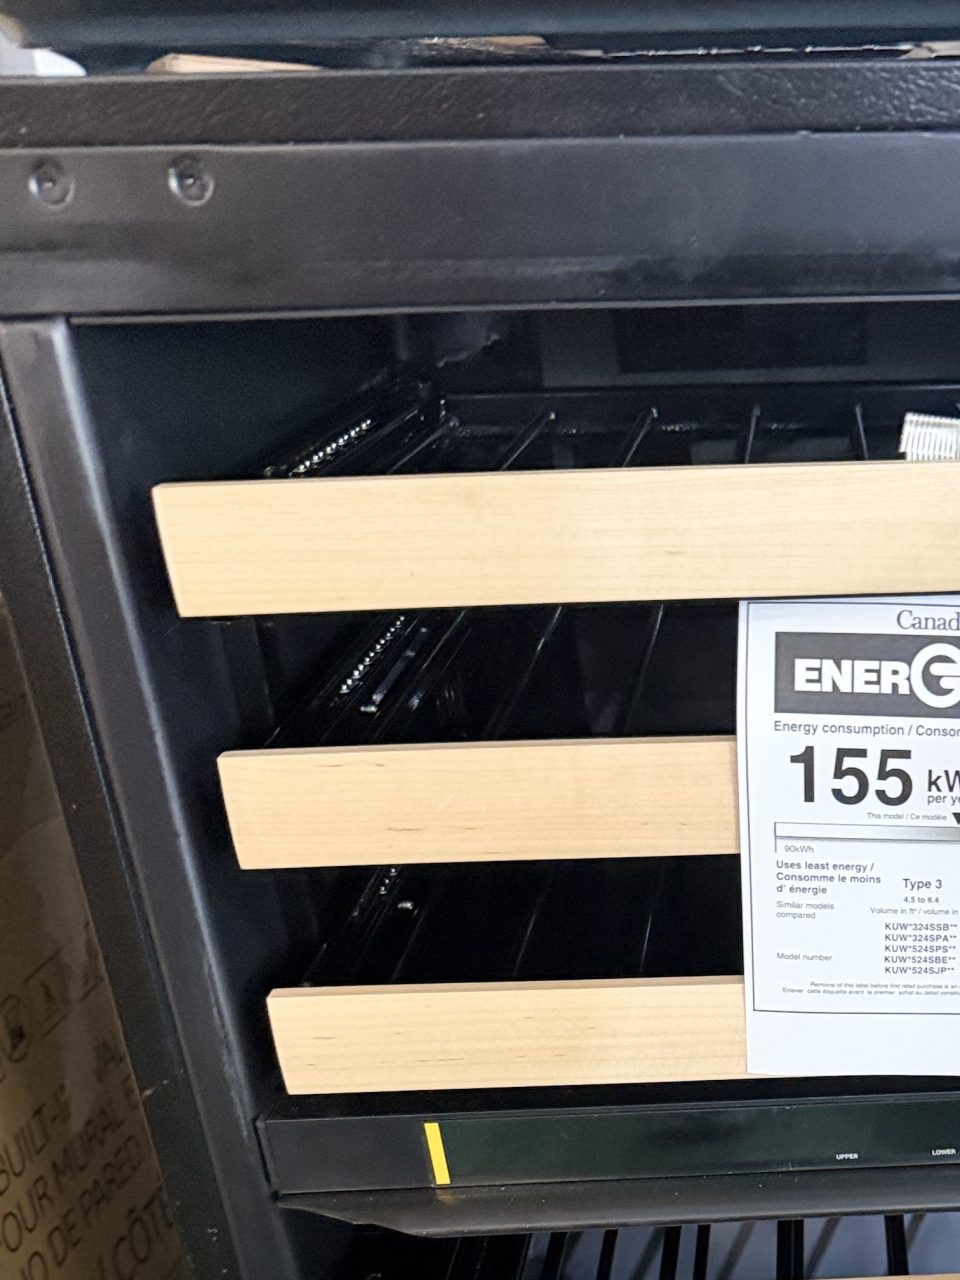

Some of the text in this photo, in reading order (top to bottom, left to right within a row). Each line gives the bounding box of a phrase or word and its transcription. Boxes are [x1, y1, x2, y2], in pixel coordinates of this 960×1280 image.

[774, 720, 818, 736] Energy
[822, 723, 905, 737] consumption
[907, 724, 913, 736] /
[790, 745, 913, 806] 155
[927, 794, 947, 806] per
[866, 812, 882, 820] This
[883, 812, 904, 820] model
[784, 844, 814, 854] 90kWh
[776, 860, 802, 870] Uses
[804, 861, 830, 871] least
[832, 863, 868, 873] energy
[776, 872, 881, 884] Consomme le moins
[902, 878, 943, 890] Type 3
[789, 885, 828, 896] énergie
[776, 900, 803, 909] Similar
[903, 896, 915, 904] 4.5
[917, 896, 926, 904] to
[870, 906, 899, 914] Volume
[776, 911, 816, 920] compared
[776, 952, 801, 960] Model
[931, 1148, 957, 1156] LOWER
[48, 1208, 83, 1268] DE
